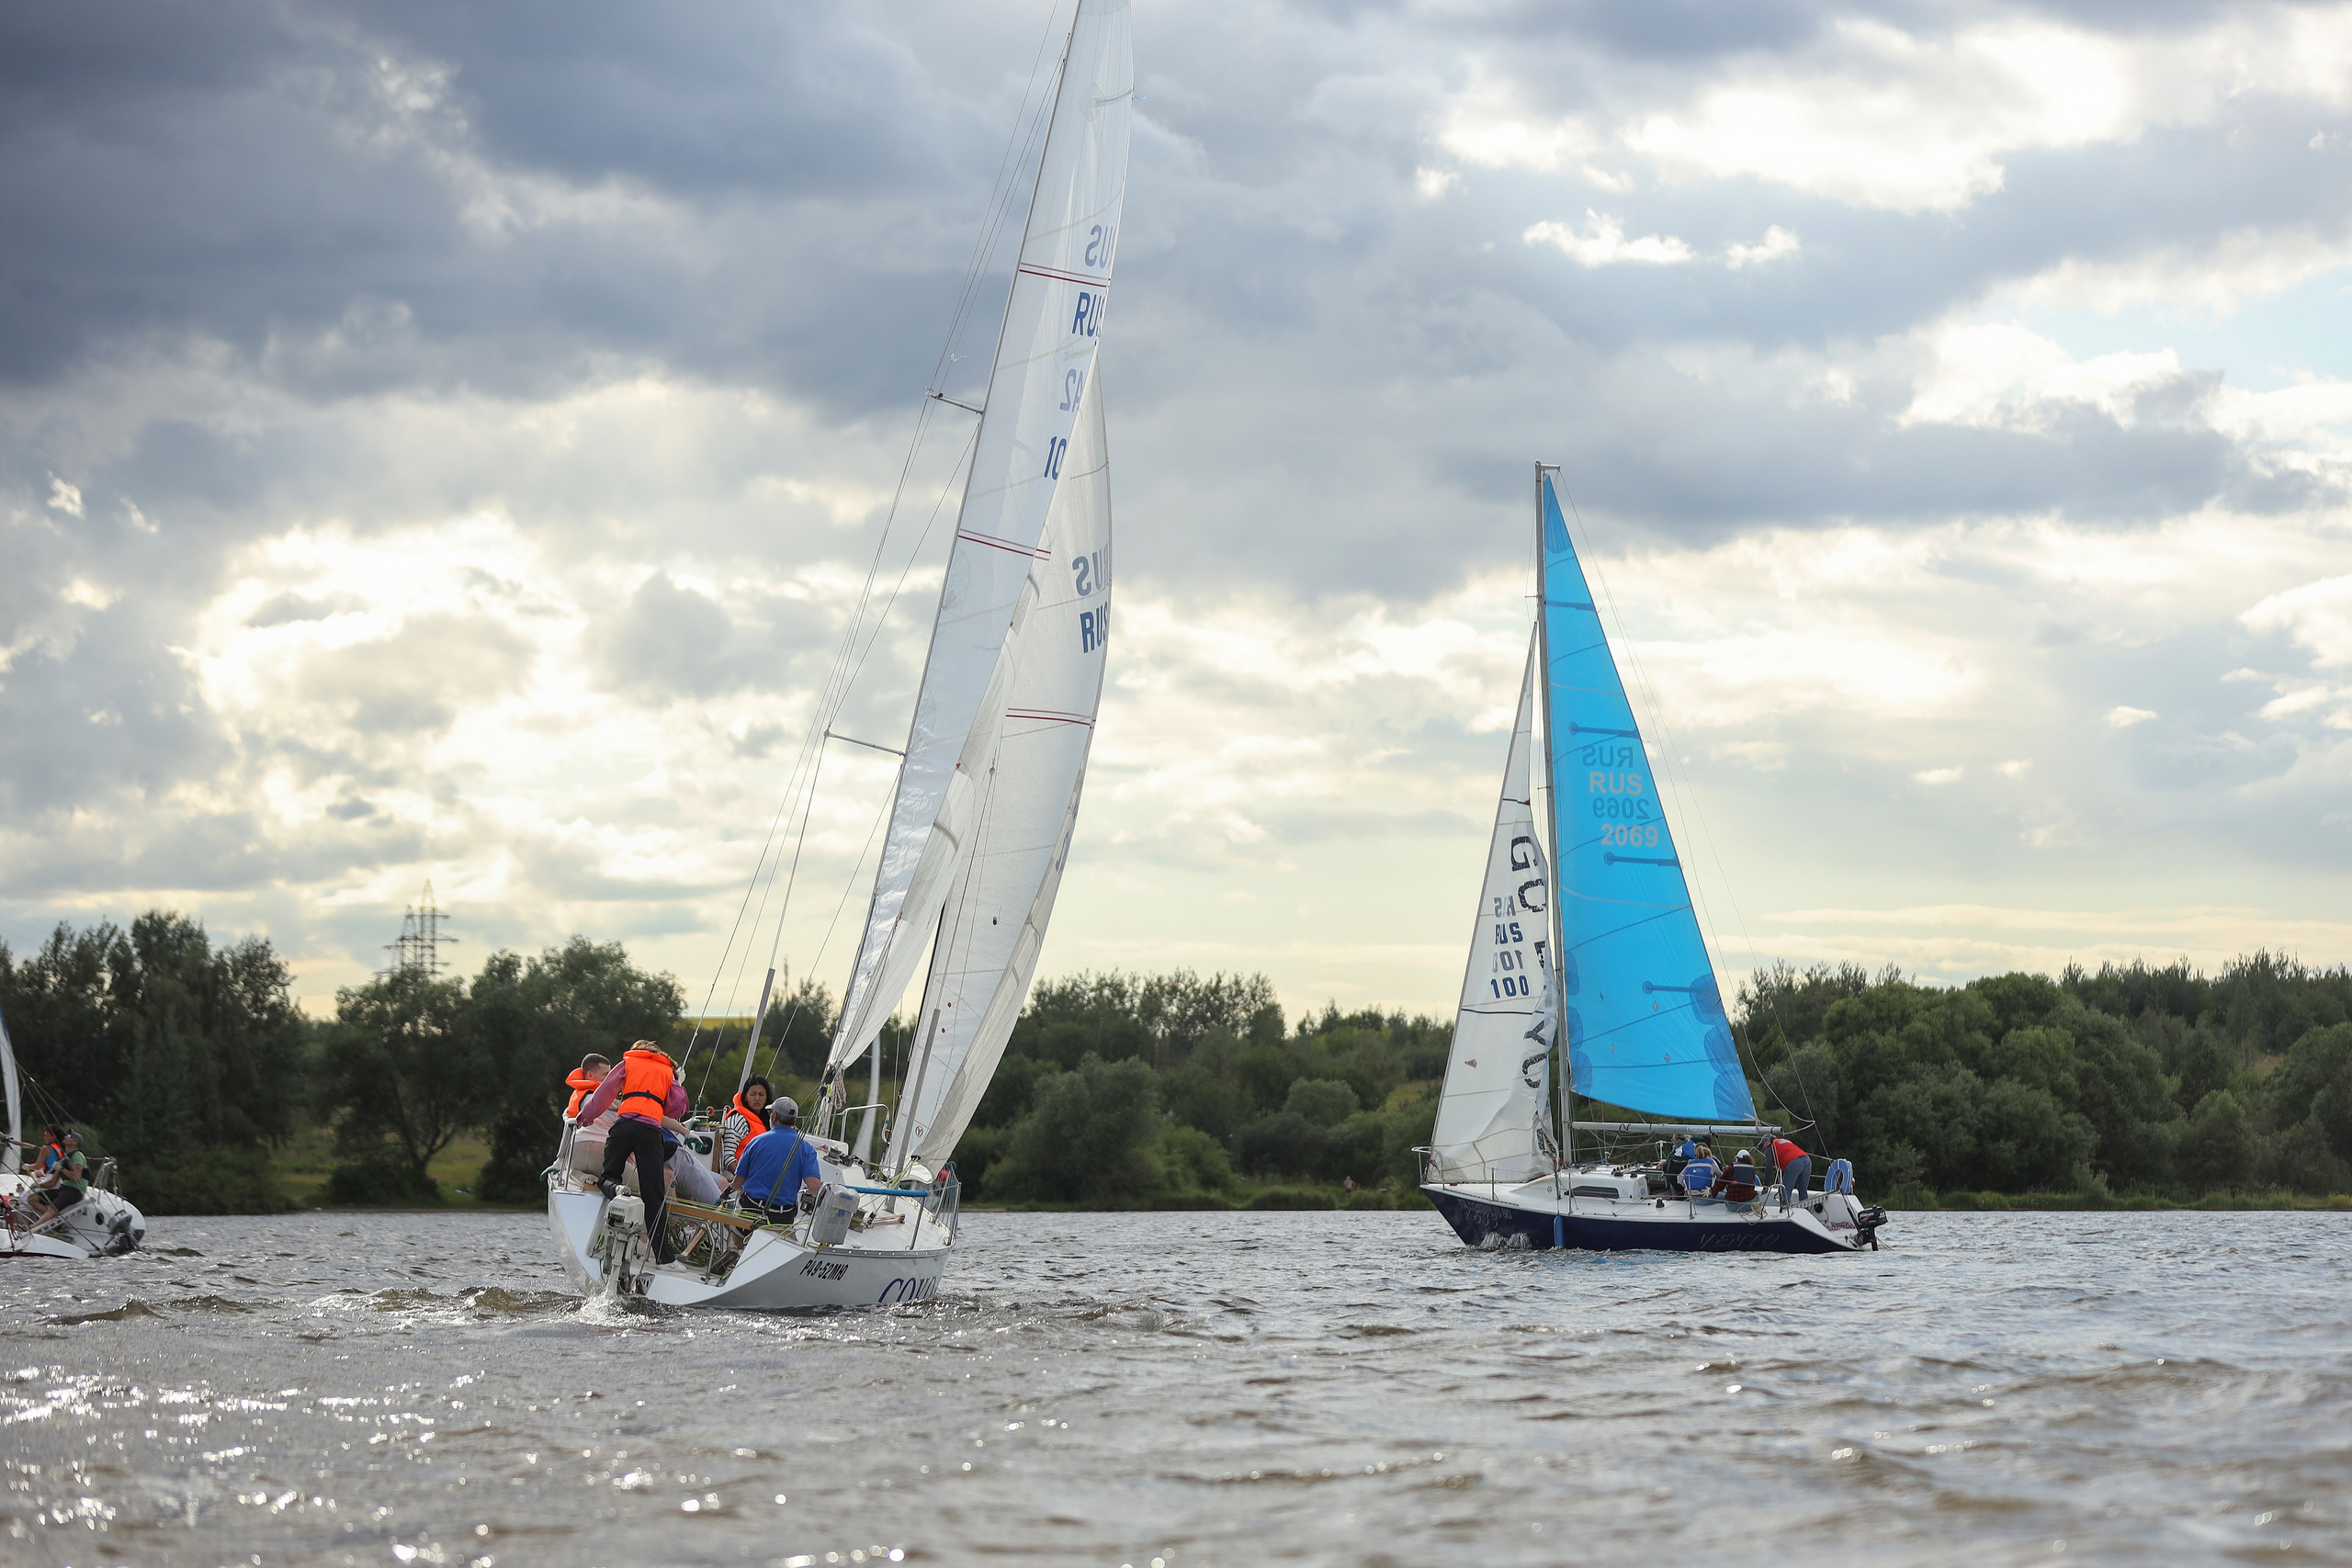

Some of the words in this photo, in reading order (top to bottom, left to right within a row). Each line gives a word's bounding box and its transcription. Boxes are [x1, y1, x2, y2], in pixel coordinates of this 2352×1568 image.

[1589, 772, 1643, 795] RUS
[1600, 824, 1658, 848] 2069
[1495, 922, 1523, 945] RUS
[1490, 976, 1529, 998] 100
